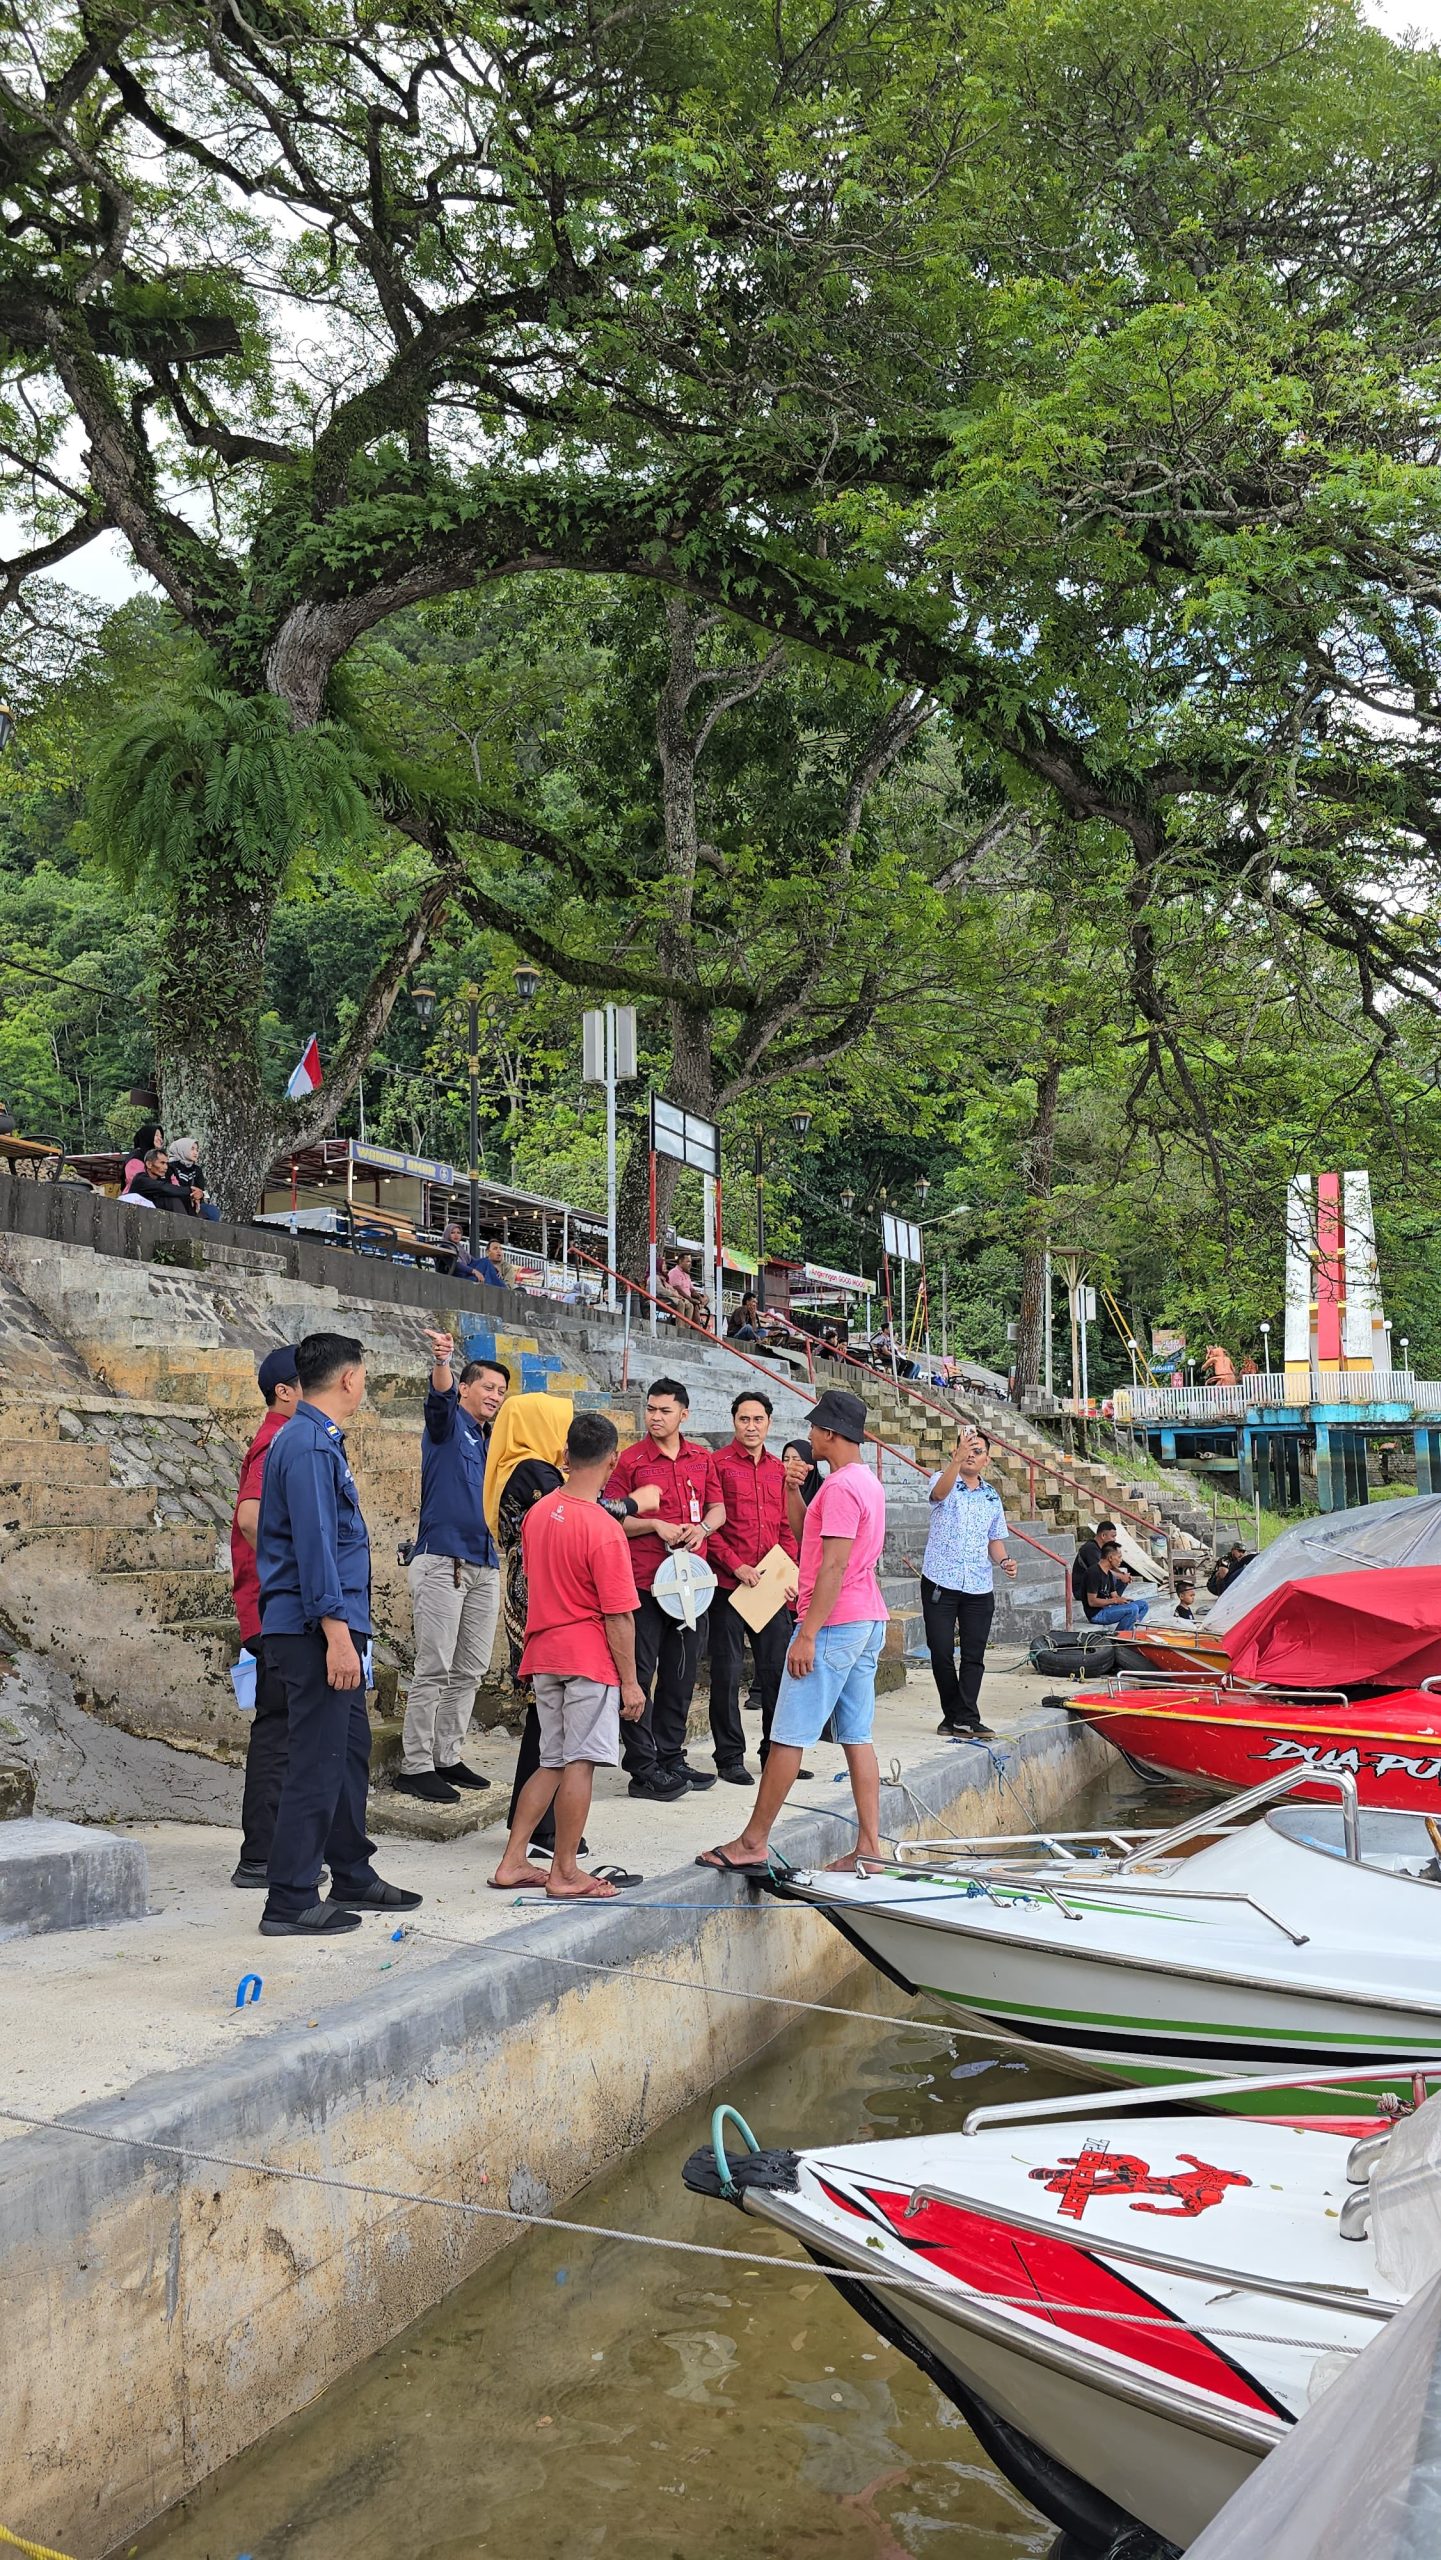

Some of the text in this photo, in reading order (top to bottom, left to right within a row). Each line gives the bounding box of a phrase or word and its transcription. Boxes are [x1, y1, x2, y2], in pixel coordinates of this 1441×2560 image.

[356, 1145, 404, 1168] WARUNG
[1247, 1736, 1441, 1783] DUA PU
